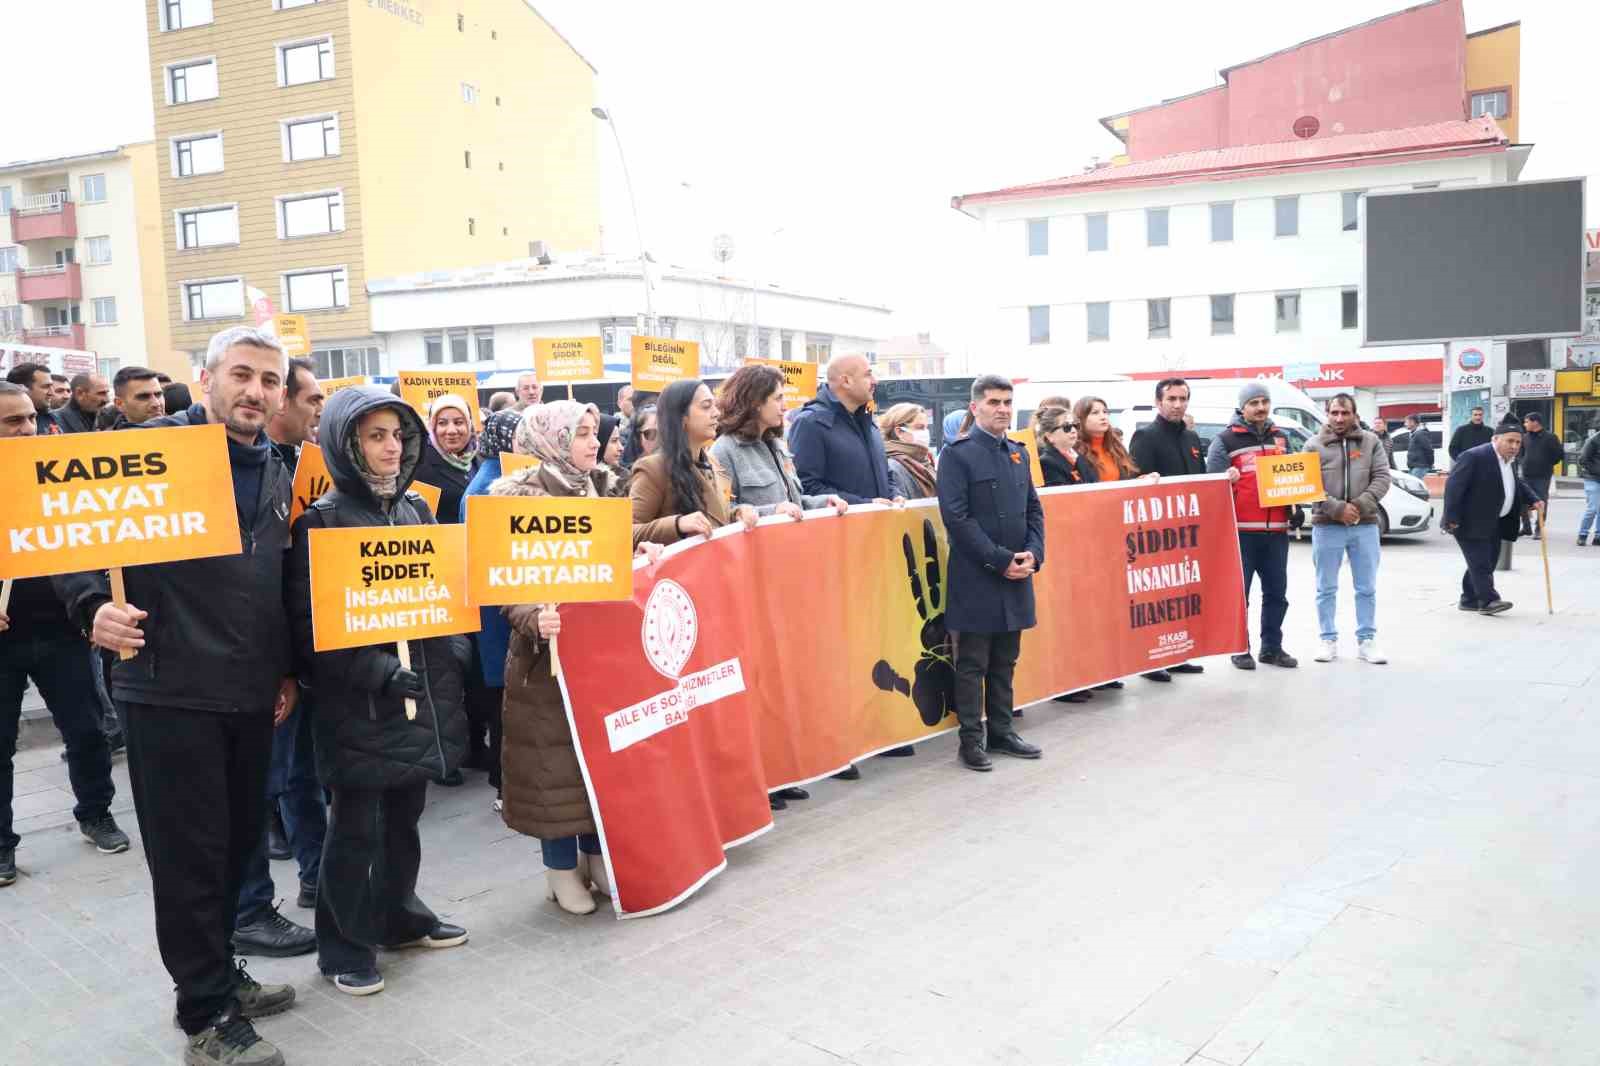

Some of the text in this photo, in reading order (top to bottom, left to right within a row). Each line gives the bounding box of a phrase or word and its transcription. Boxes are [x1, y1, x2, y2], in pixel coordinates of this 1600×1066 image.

[403, 376, 472, 386] KADIN VE ERKEK
[35, 452, 168, 484] KADES
[1272, 462, 1305, 473] KADES
[41, 482, 169, 517] HAYAT
[1123, 493, 1200, 524] KADINA
[9, 511, 207, 553] KURTARIR
[510, 515, 593, 534] KADES
[360, 539, 435, 557] KADINA
[511, 540, 592, 560] HAYAT
[1126, 524, 1200, 563] ŞİDDET
[361, 562, 434, 587] ŞİDDET,
[488, 564, 613, 586] KURTARIR
[1127, 555, 1201, 594] İNSANLIĞA
[345, 582, 450, 608] İNSANLIĞA
[345, 606, 453, 633] İHANETTİR.
[613, 709, 641, 731] AİLE
[641, 702, 658, 718] VE
